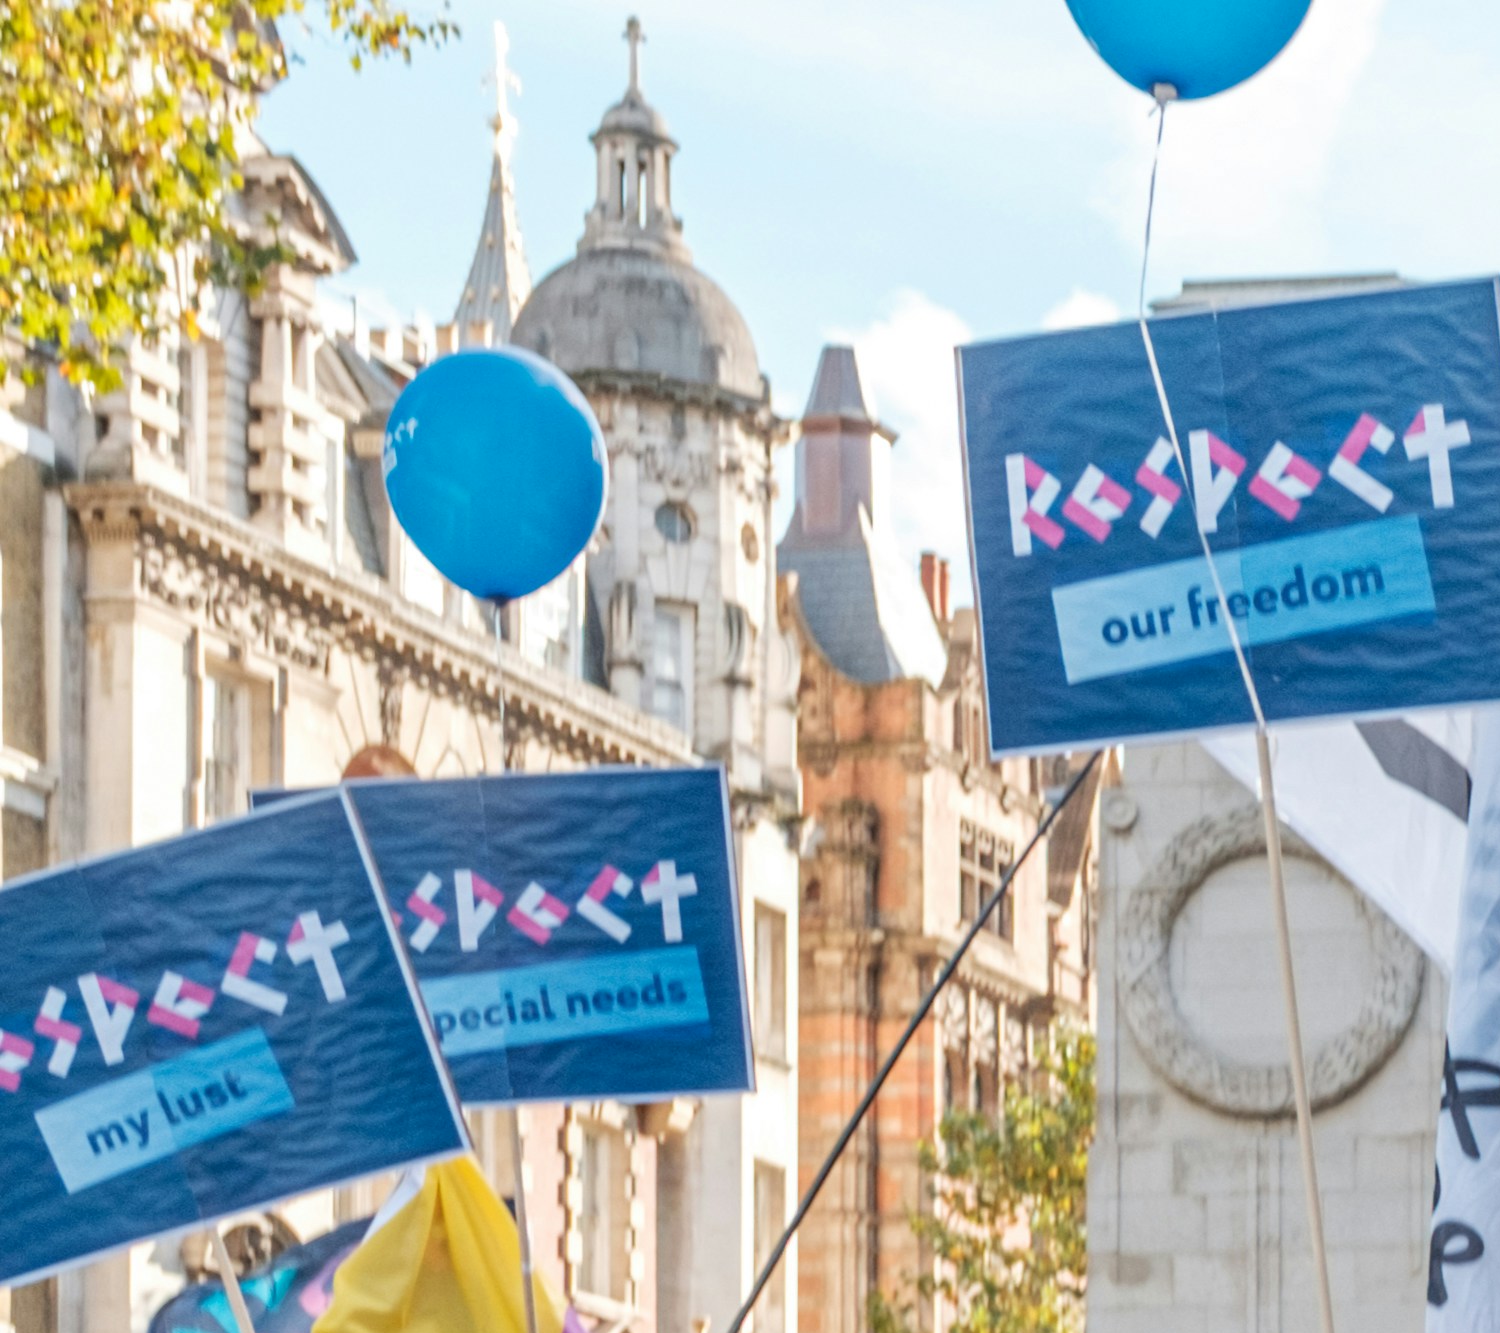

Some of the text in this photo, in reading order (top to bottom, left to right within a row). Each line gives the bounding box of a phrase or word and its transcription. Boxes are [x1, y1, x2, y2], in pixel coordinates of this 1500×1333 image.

[1101, 559, 1386, 646] our freedom
[434, 972, 687, 1042] pecial needs
[85, 1068, 249, 1156] my lust
